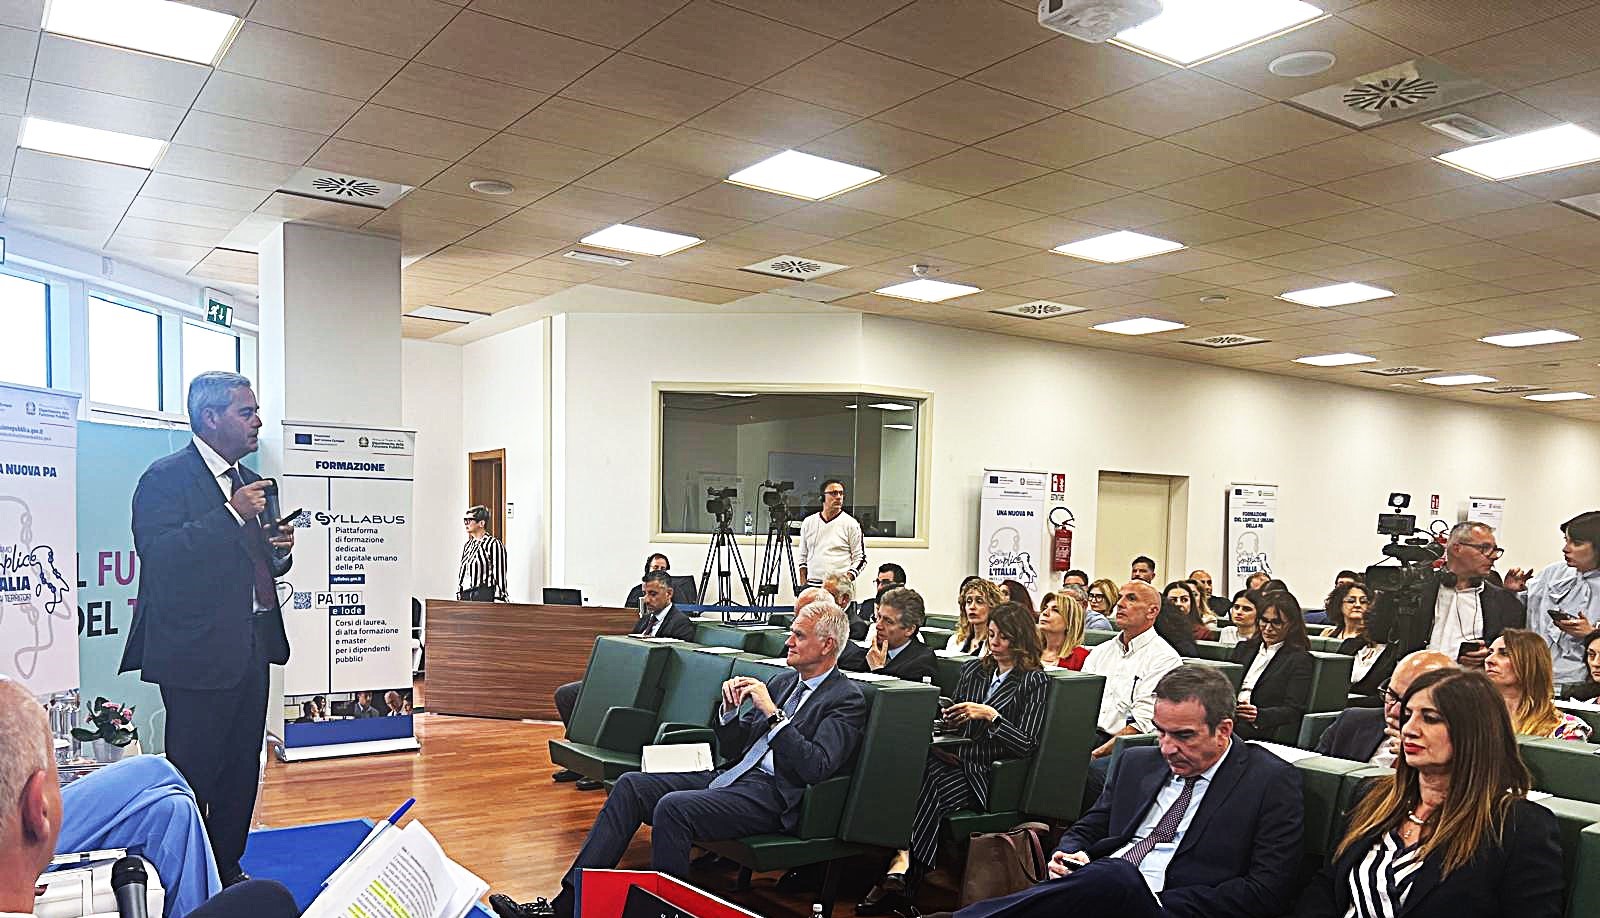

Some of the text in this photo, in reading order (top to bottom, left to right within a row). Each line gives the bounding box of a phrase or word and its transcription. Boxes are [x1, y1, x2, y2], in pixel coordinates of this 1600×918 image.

[5, 463, 41, 477] NUOVA
[42, 466, 57, 478] PA
[315, 460, 386, 472] FORMAZIONE
[314, 511, 406, 526] SYLLABUS
[335, 526, 379, 534] Piattaforma
[335, 535, 385, 544] di formazione
[335, 545, 366, 553] dedicata
[335, 554, 342, 562] al
[343, 554, 372, 564] capitale
[335, 563, 365, 571] delle PA
[989, 567, 1017, 576] L'ITALIA
[317, 593, 359, 605] PA 110
[341, 607, 362, 615] lode
[335, 618, 387, 627] Corsi di laurea,
[335, 628, 342, 636] di
[359, 628, 399, 636] formazione
[341, 637, 367, 645] master
[335, 647, 347, 656] per
[353, 645, 390, 655] dipendenti
[335, 655, 363, 665] pubblici
